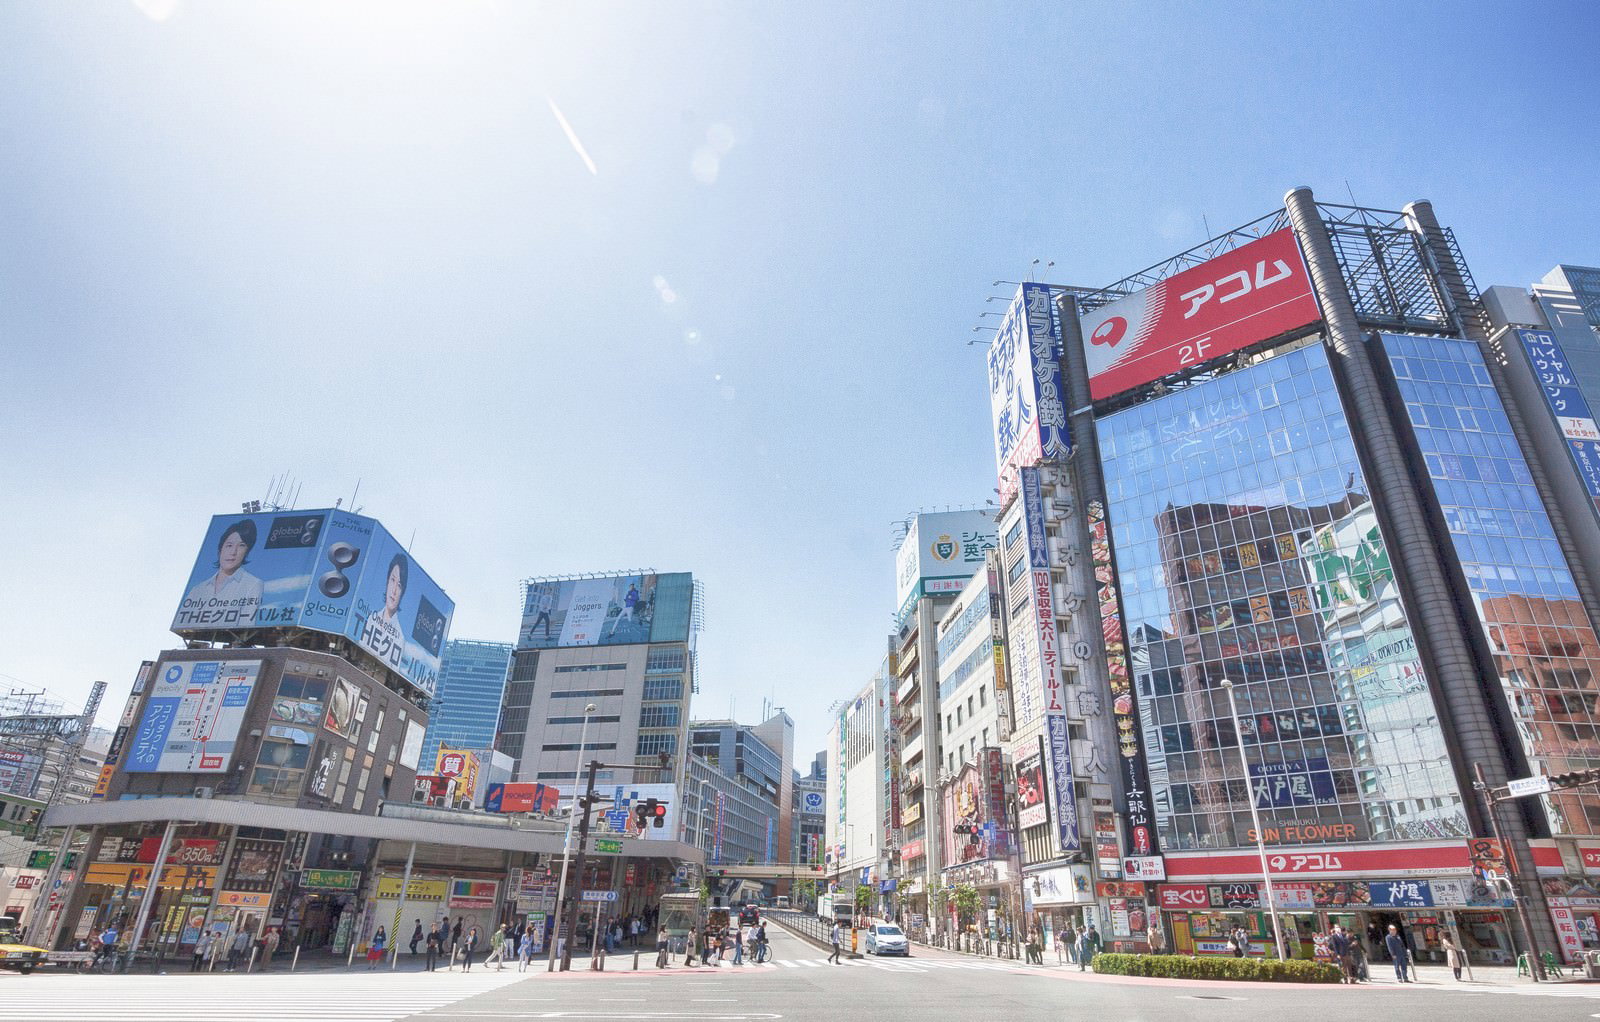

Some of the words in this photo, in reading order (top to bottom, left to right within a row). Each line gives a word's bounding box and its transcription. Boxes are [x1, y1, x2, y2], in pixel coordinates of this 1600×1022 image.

[1180, 258, 1293, 320] アコム
[1178, 336, 1213, 365] 2F
[1538, 333, 1571, 386] ロイヤル
[1026, 286, 1070, 458] カラオケの鉄人
[1531, 346, 1567, 412] ハウジング
[1569, 419, 1583, 428] 7F
[1024, 469, 1047, 567] カラオケの鉄人
[270, 526, 303, 542] global
[179, 606, 296, 624] THEグローバル社
[182, 598, 207, 610] Only
[208, 597, 230, 608] One
[230, 597, 263, 607] の住まい
[304, 601, 350, 617] global
[357, 598, 373, 619] Only
[372, 609, 385, 627] One
[573, 602, 602, 612] Joggers
[353, 612, 436, 693] THEグローバル社
[1033, 571, 1063, 711] 100名収容大パーティールーム
[135, 704, 164, 764] アイシティ
[145, 704, 172, 764] コンタクトの
[444, 757, 460, 773] 質
[1257, 762, 1301, 773] OOTOYA
[1050, 716, 1079, 848] カラオケの鉄人
[1253, 774, 1313, 808] 大戸屋
[805, 805, 823, 813] Keio
[1126, 788, 1147, 827] 六歌仙
[1247, 829, 1281, 843] SUN
[1285, 824, 1357, 841] FLOWER
[1291, 854, 1343, 870] アコム
[17, 876, 35, 885] ATM
[1388, 880, 1424, 903] 大戸屋
[1163, 889, 1206, 905] 宝くじ
